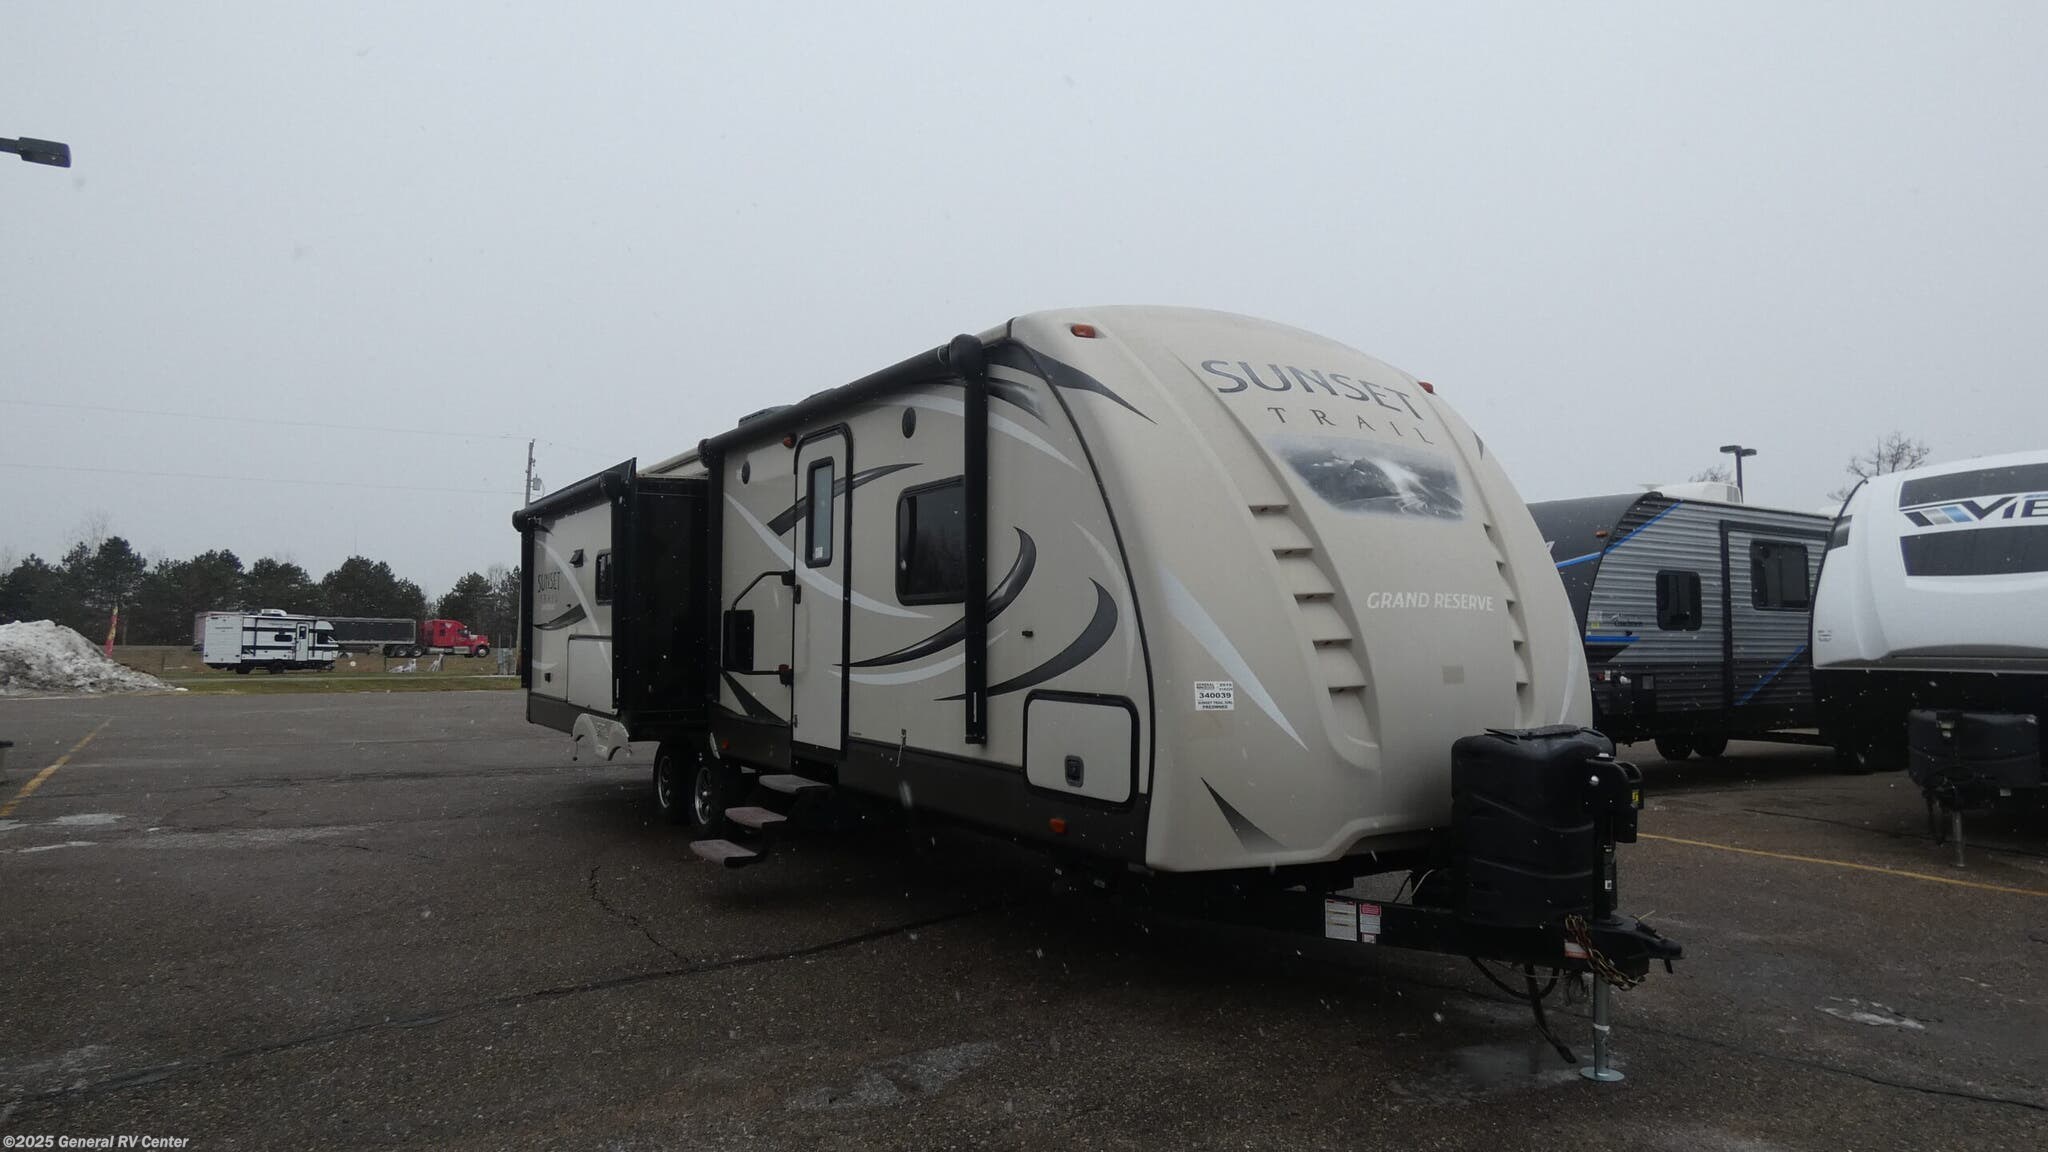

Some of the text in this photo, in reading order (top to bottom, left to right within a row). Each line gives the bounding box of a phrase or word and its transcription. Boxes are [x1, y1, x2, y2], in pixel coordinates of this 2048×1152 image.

[1201, 360, 1424, 420] SUNSET
[1267, 406, 1434, 445] TRAIL
[537, 571, 561, 593] SUNSET
[1366, 592, 1495, 611] GRAND RESERVE
